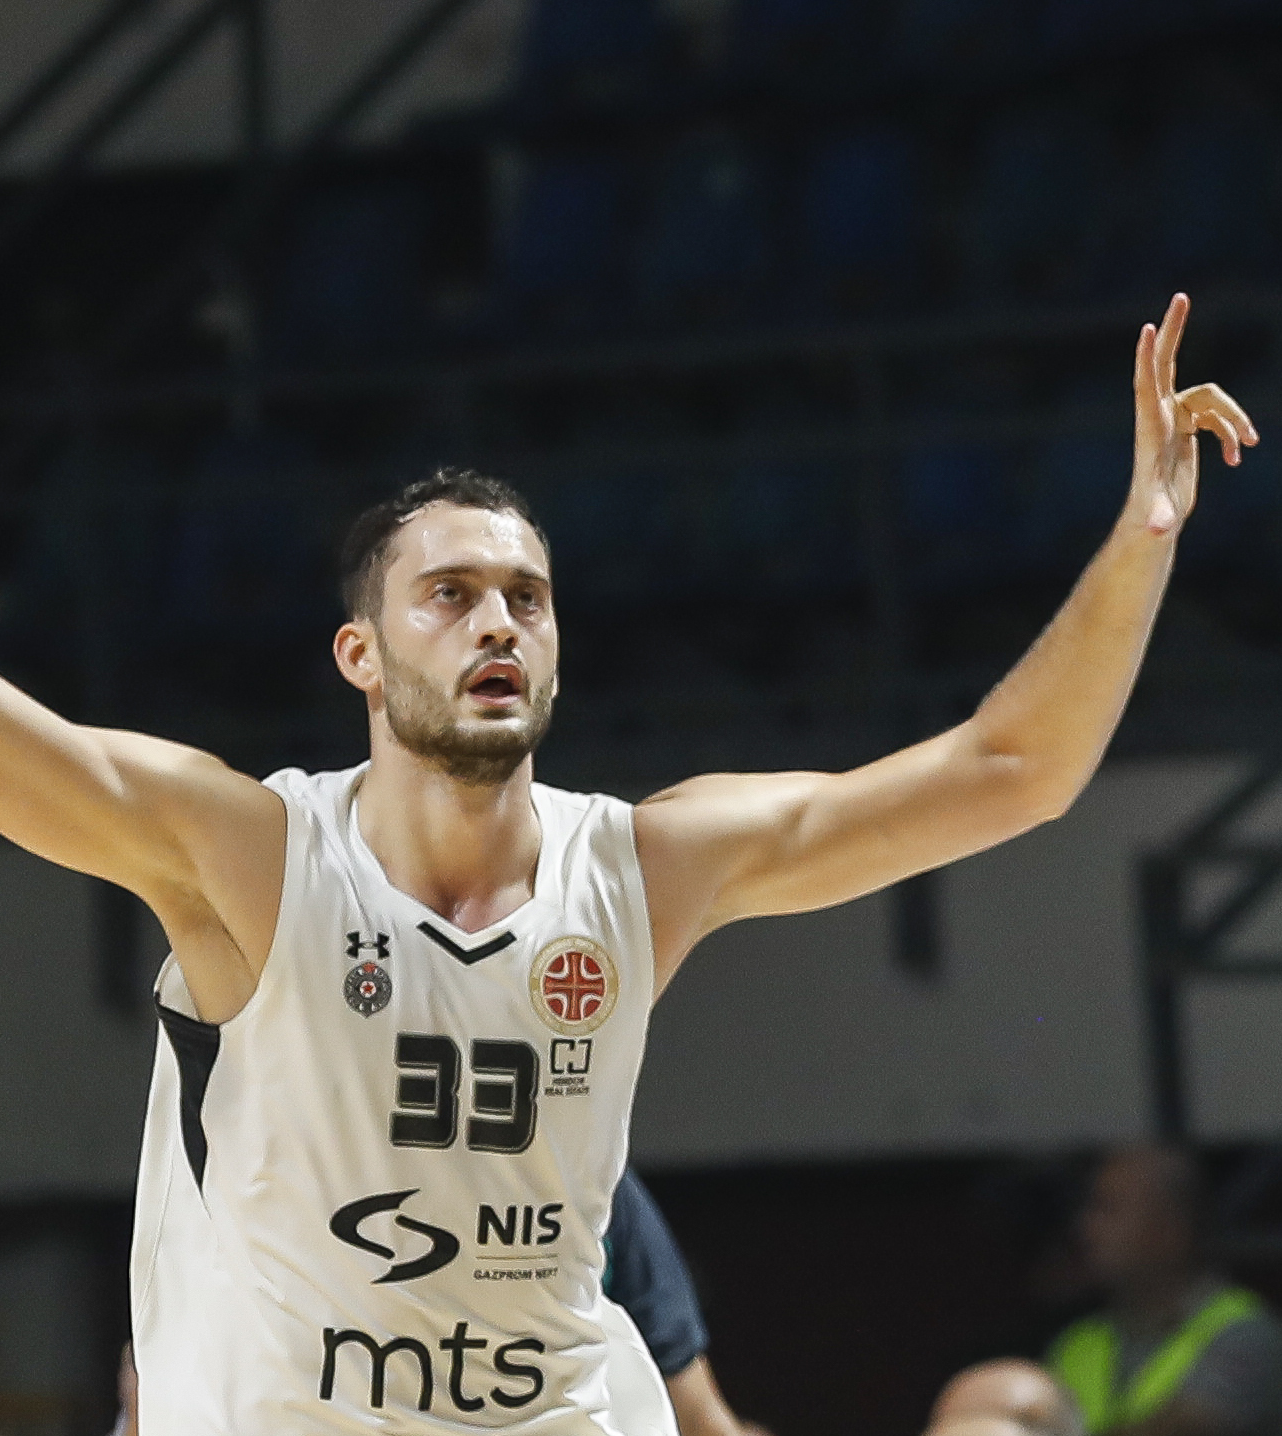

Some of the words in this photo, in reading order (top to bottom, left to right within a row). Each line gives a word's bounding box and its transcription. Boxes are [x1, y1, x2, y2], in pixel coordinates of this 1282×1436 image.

[390, 1034, 539, 1153] 33
[476, 1203, 563, 1246] NIS
[319, 1322, 545, 1412] mts
